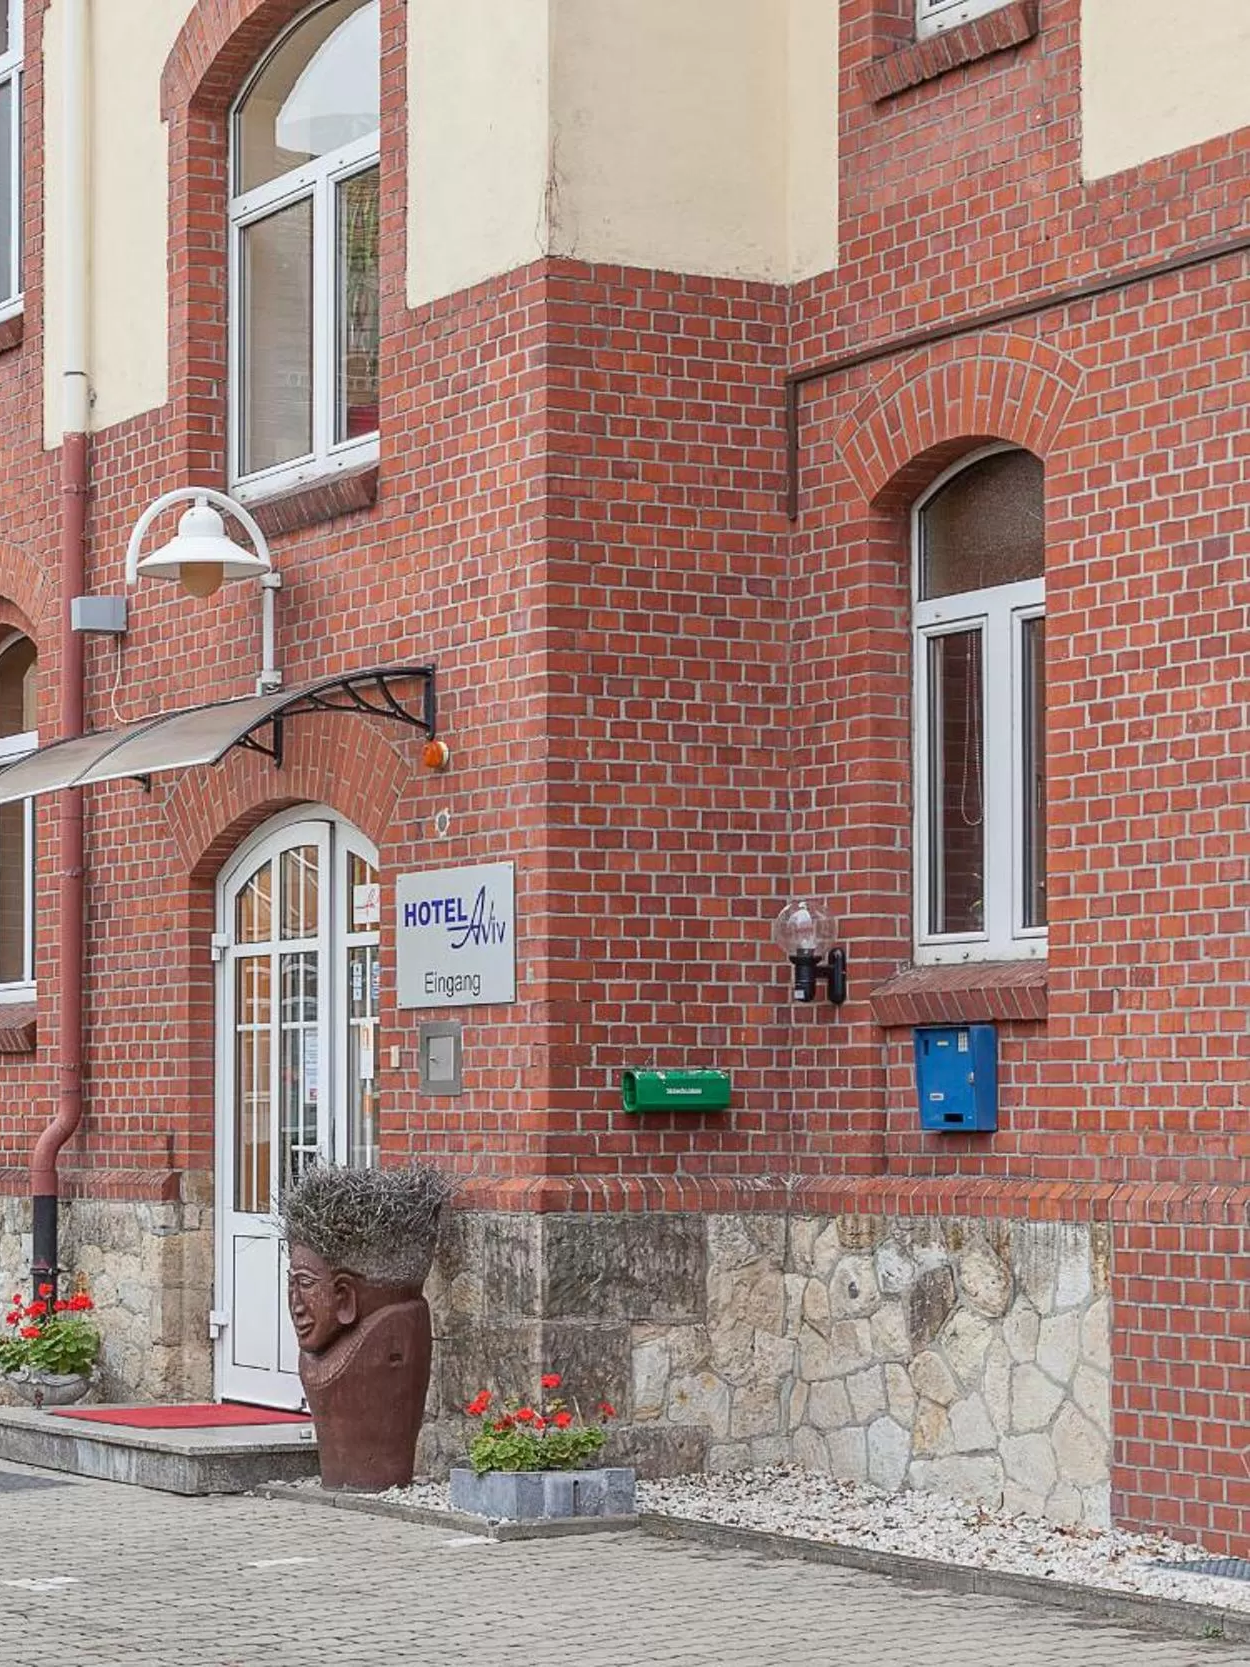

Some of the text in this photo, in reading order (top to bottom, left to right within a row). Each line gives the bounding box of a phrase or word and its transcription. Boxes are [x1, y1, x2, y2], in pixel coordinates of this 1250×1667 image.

[404, 897, 468, 928] HOTEL
[447, 885, 506, 949] Aviv
[424, 972, 481, 997] Eingang
